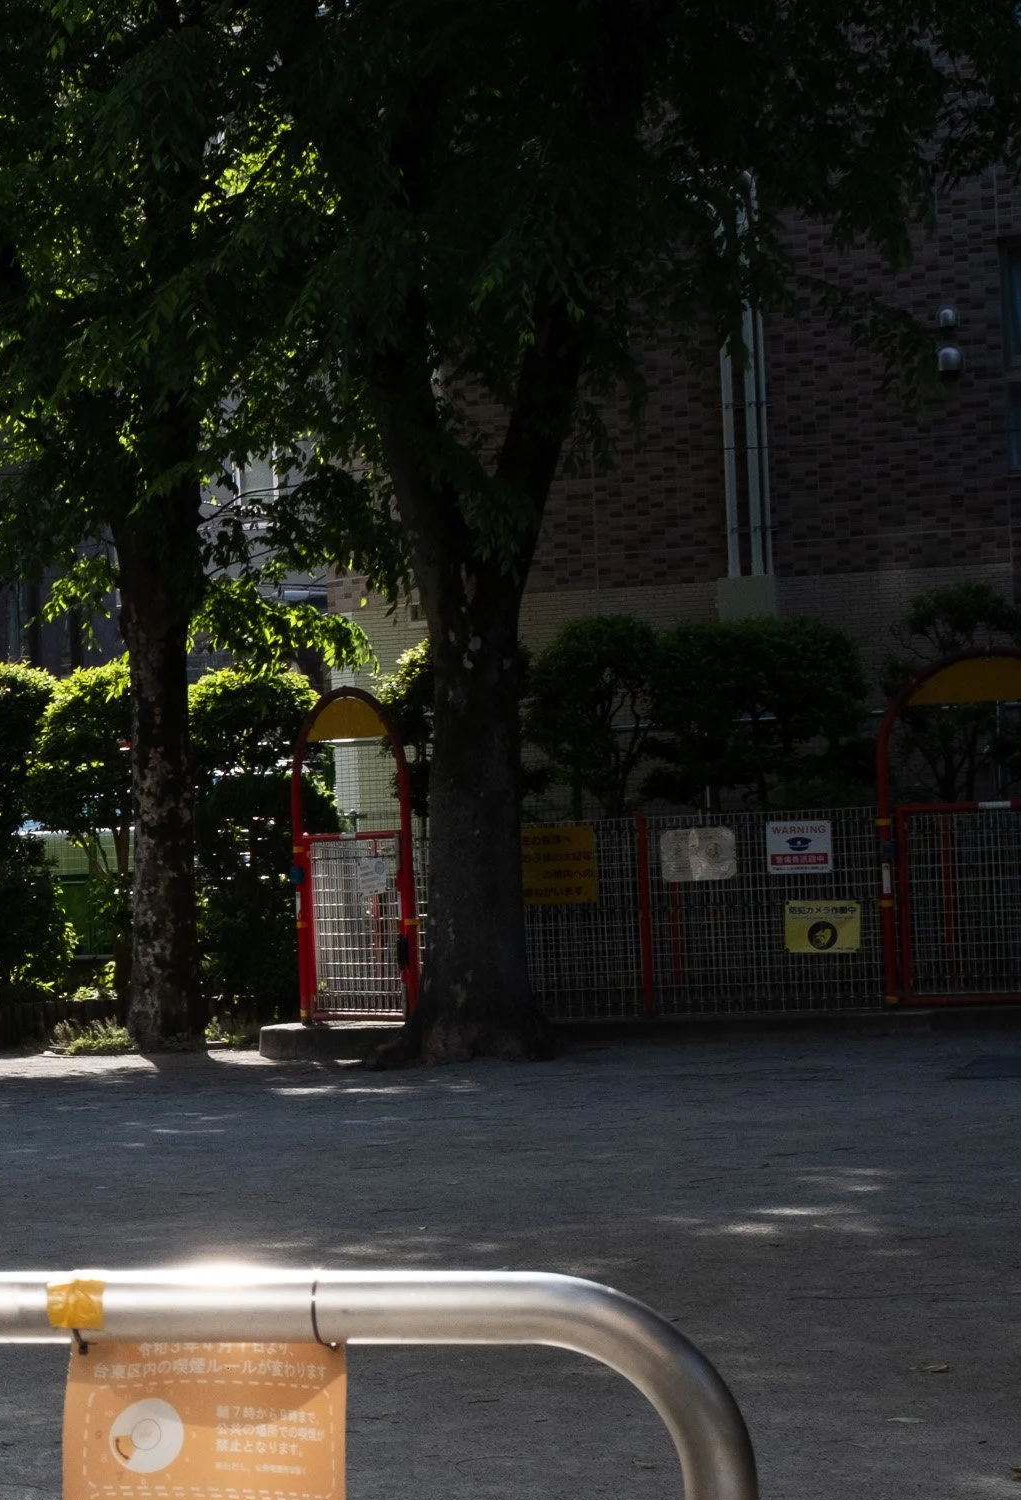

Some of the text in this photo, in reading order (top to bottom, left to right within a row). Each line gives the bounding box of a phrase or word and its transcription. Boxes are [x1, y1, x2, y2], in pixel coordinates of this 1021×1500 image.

[771, 825, 826, 835] WARNING
[788, 906, 856, 915] 防犯カメラ作動中
[92, 1358, 328, 1381] 台東区内の喫煙ルールが変わります
[215, 1439, 304, 1458] 禁止となります。
